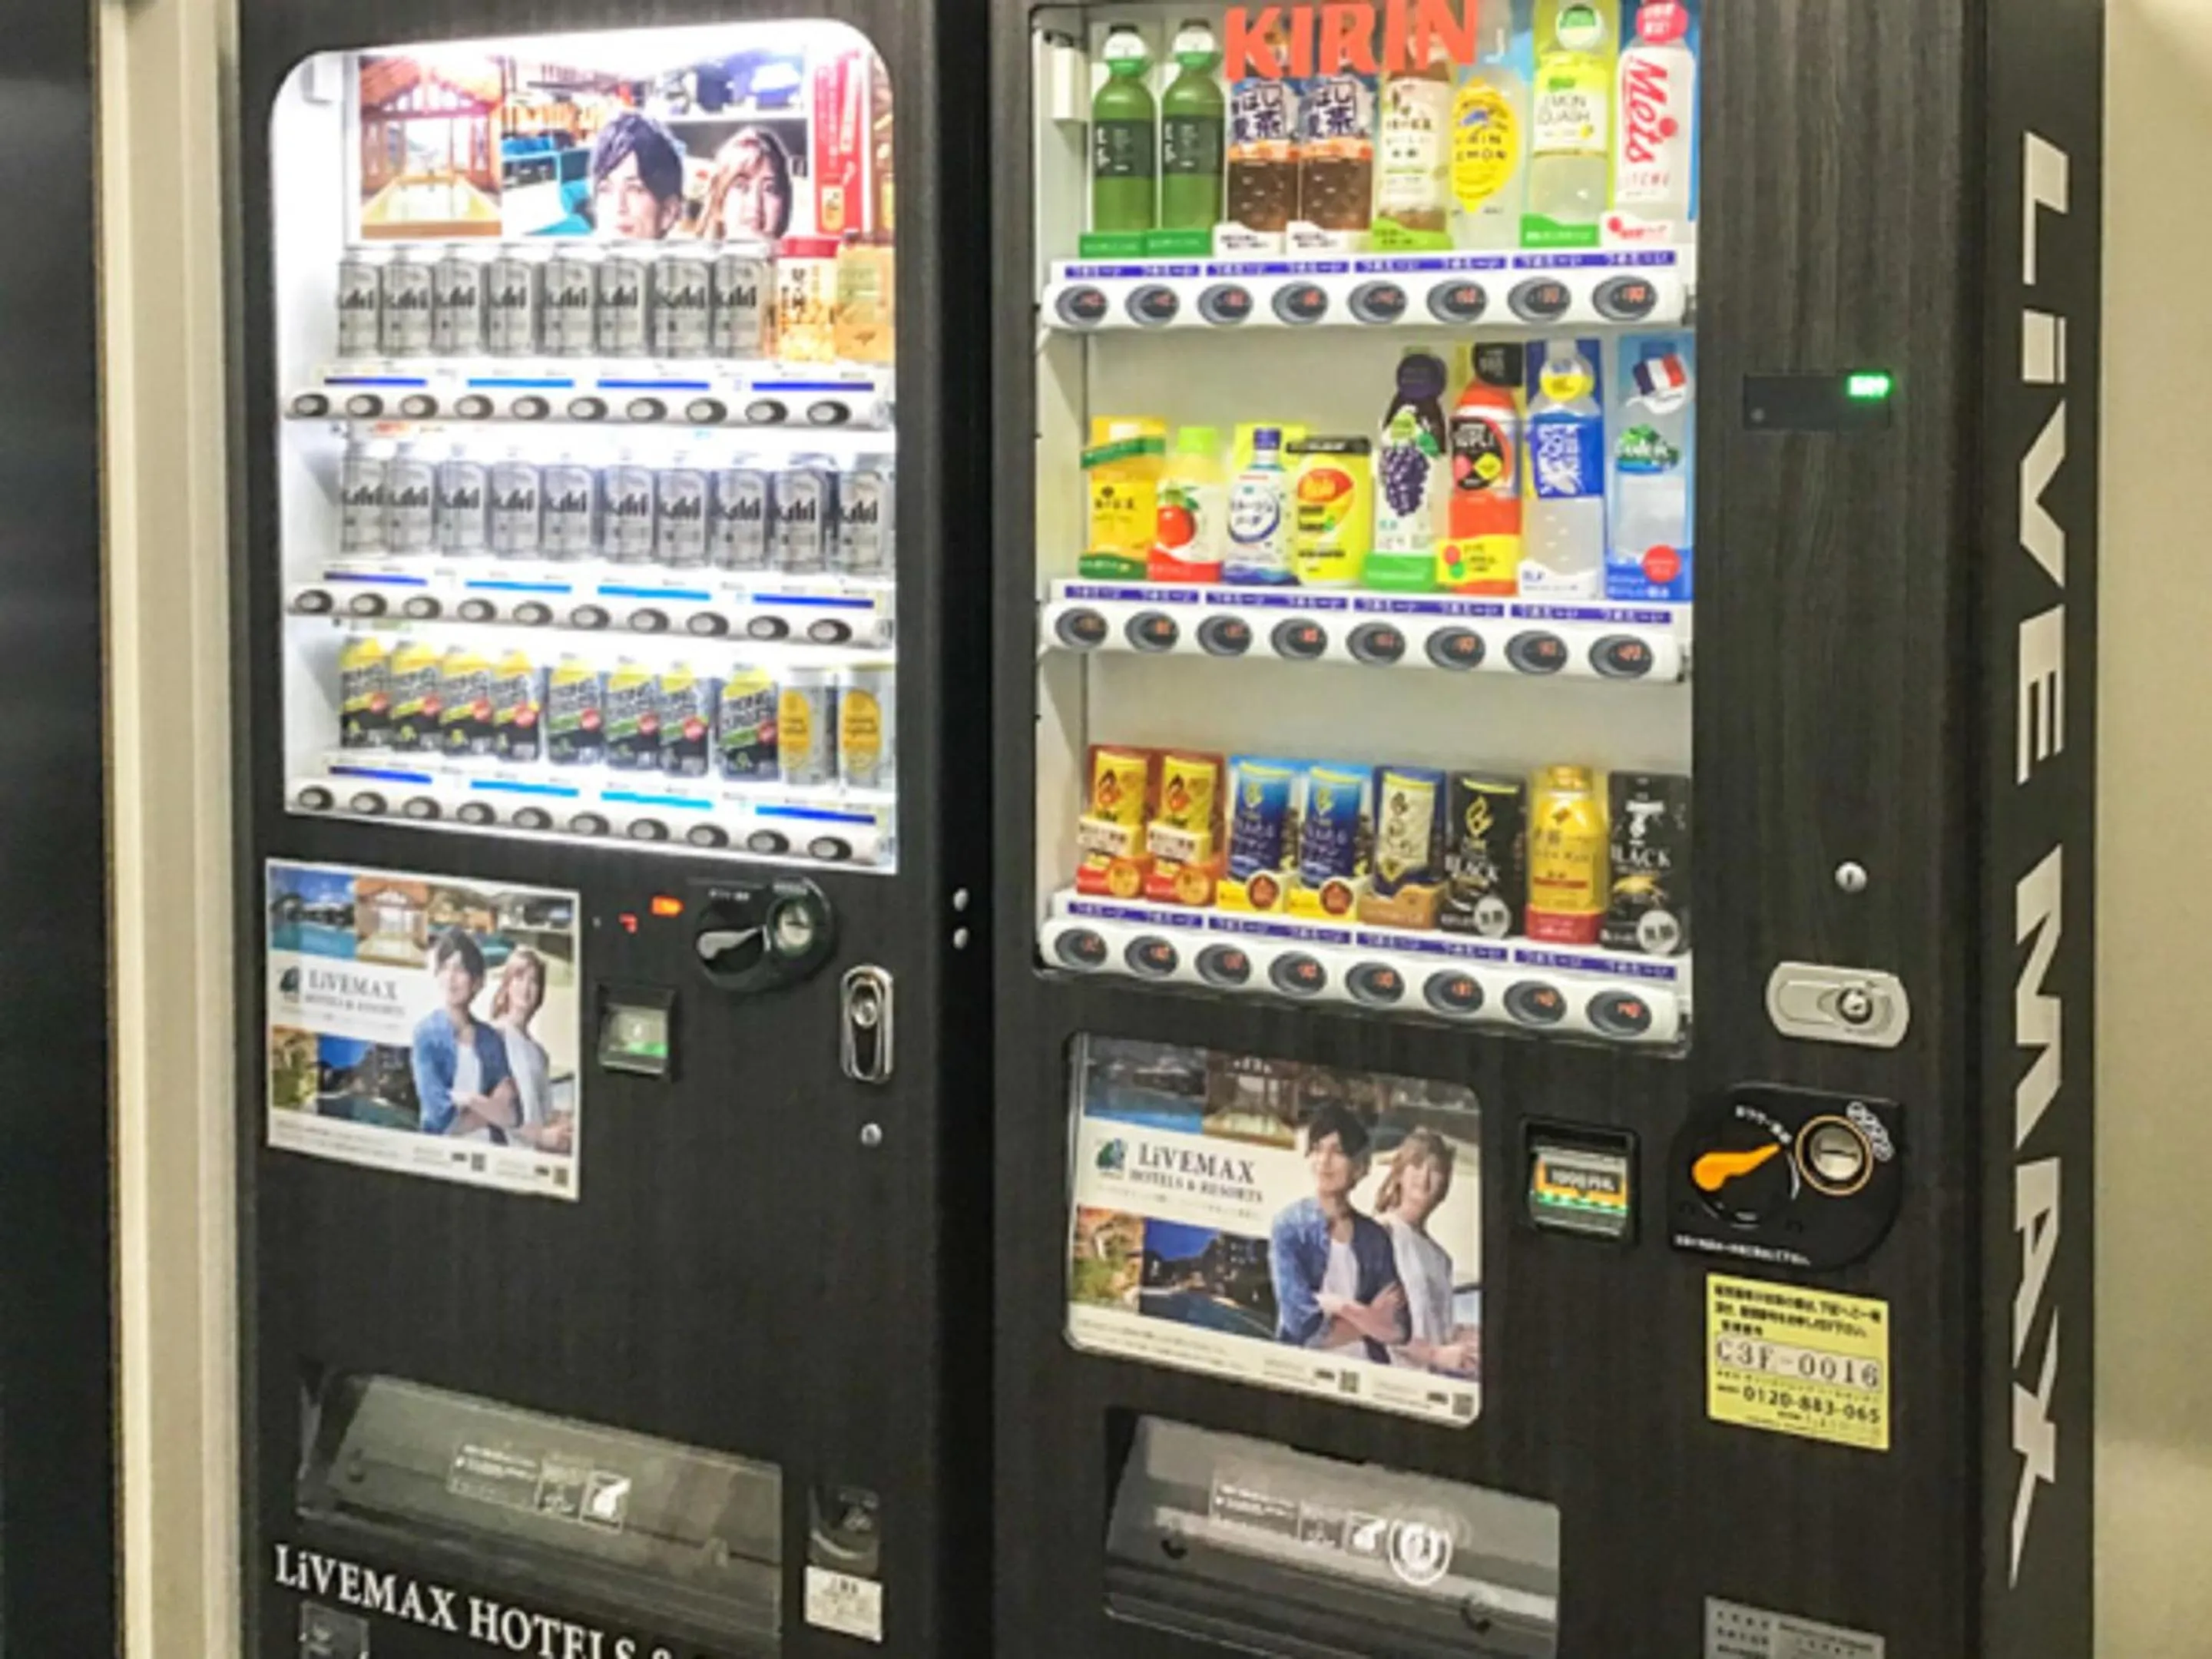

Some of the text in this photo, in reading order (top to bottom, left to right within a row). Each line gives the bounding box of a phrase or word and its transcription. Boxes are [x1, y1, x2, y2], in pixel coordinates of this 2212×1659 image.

[1224, 0, 1476, 81] KIRIN
[1138, 1142, 1255, 1184] LiVEMAX
[275, 1544, 459, 1632] LiVEMAX
